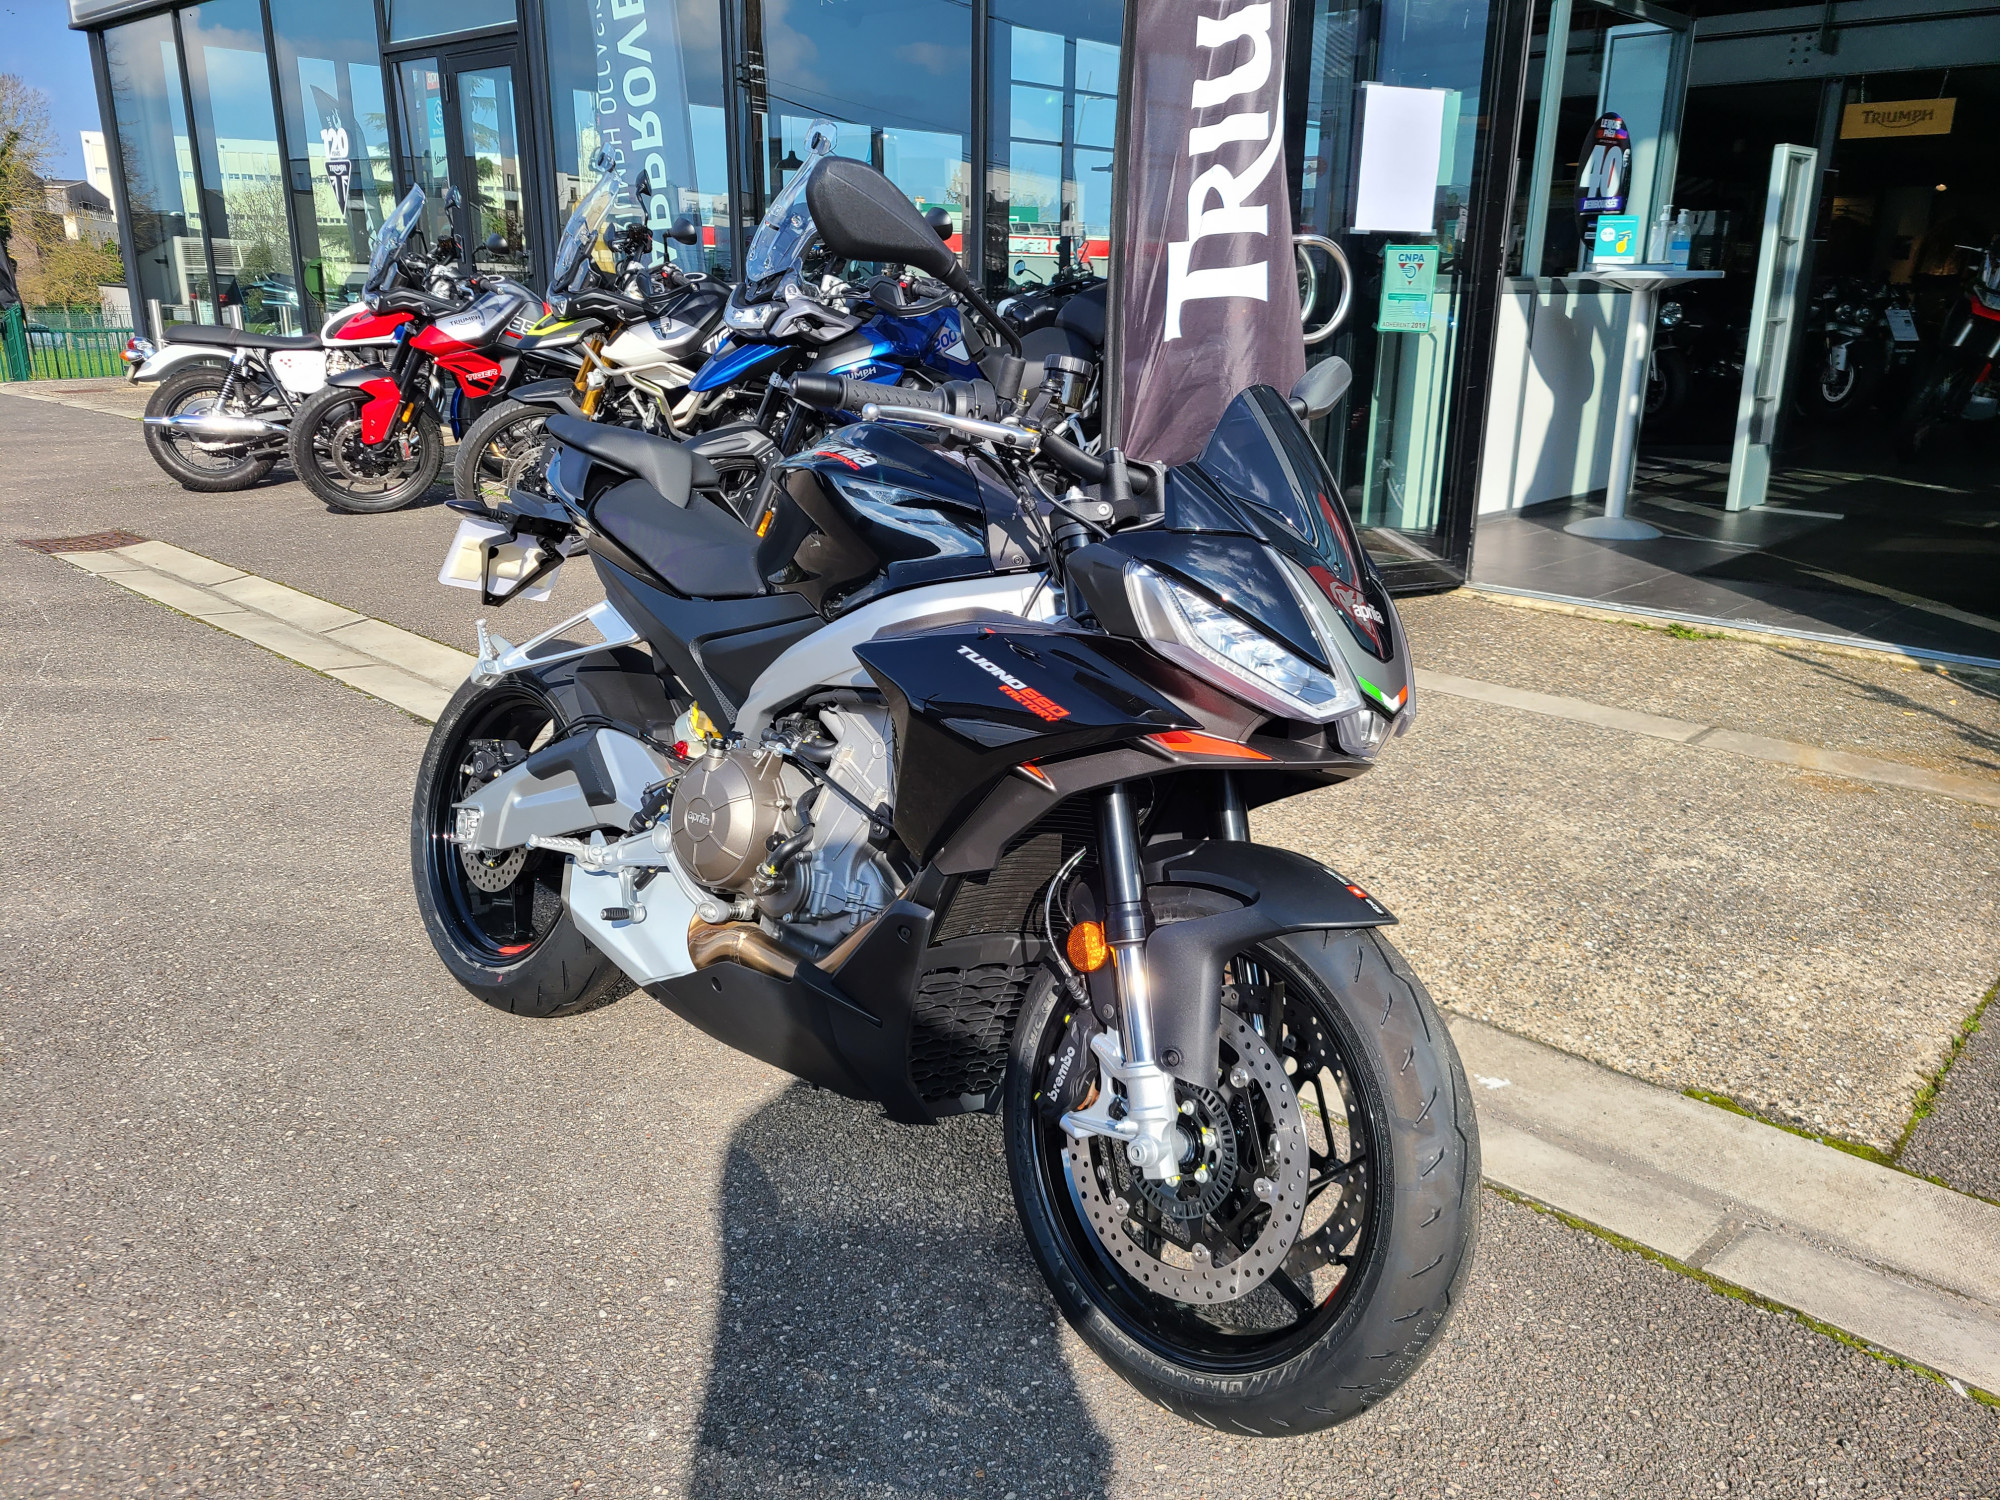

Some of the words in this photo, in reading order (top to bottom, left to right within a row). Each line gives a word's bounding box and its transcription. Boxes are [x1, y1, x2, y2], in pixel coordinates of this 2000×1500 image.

[1862, 108, 1934, 128] TRIUMPH
[320, 127, 349, 159] 120
[1579, 145, 1623, 199] 40
[1398, 253, 1425, 262] CNPA
[450, 315, 481, 327] TRIUMPH
[466, 368, 498, 380] TIGER
[1352, 603, 1385, 626] aprilia
[957, 645, 1028, 690] TUONO
[1018, 687, 1071, 718] 660
[998, 685, 1059, 722] FACTORY
[687, 810, 711, 826] aprilia
[1047, 1046, 1076, 1103] brembo
